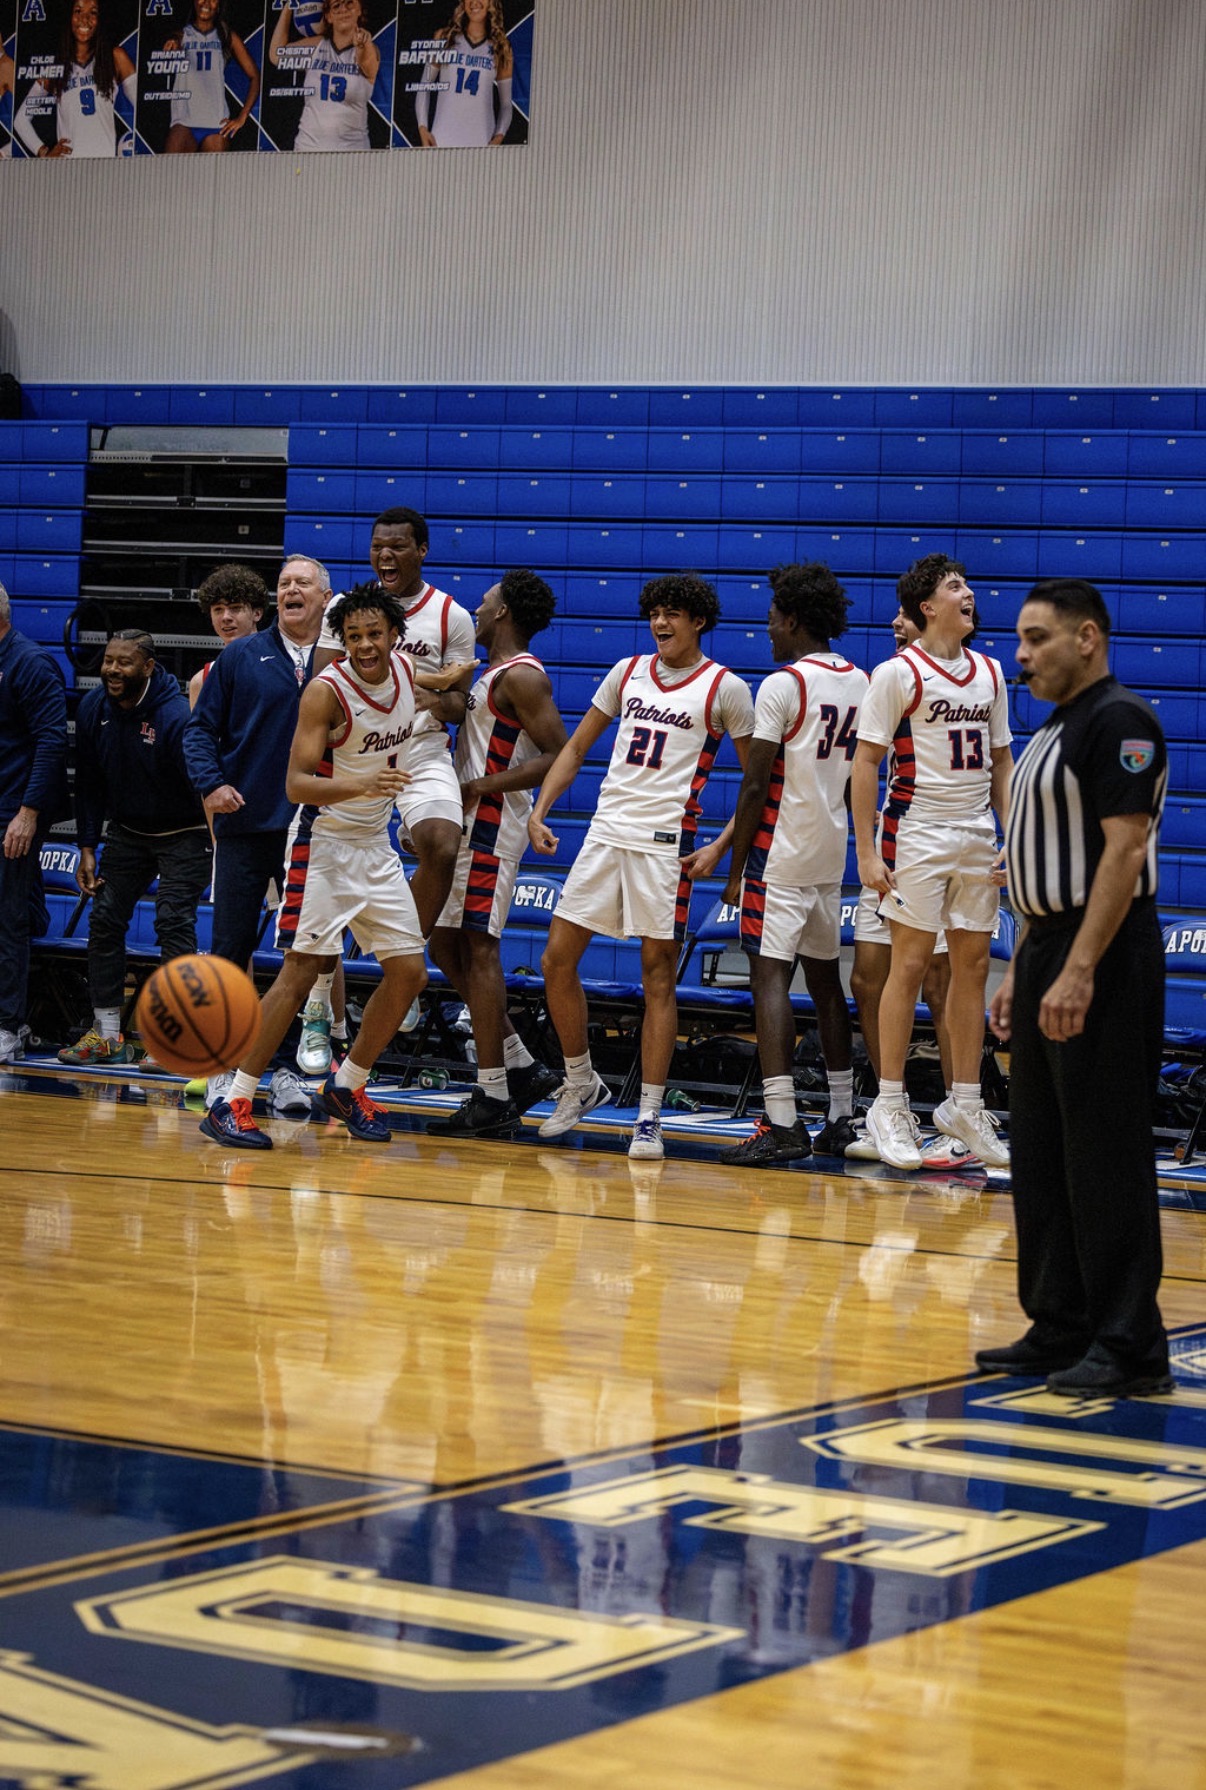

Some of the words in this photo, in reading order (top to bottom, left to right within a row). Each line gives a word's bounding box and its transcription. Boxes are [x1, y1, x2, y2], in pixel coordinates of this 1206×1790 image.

[399, 50, 457, 65] BARTKIN
[411, 40, 447, 50] SYDNEY
[17, 65, 64, 80] PALMER
[30, 56, 55, 65] CHLOE
[147, 60, 189, 74] YOUNG
[196, 51, 211, 71] 11
[320, 74, 347, 103] 13
[455, 67, 480, 96] 14
[79, 88, 96, 116] 9
[624, 697, 694, 730] Patriots
[816, 704, 857, 762] 34
[626, 726, 669, 771] 21
[948, 729, 984, 771] 13
[39, 851, 77, 874] OPKA
[512, 885, 556, 910] OPKA
